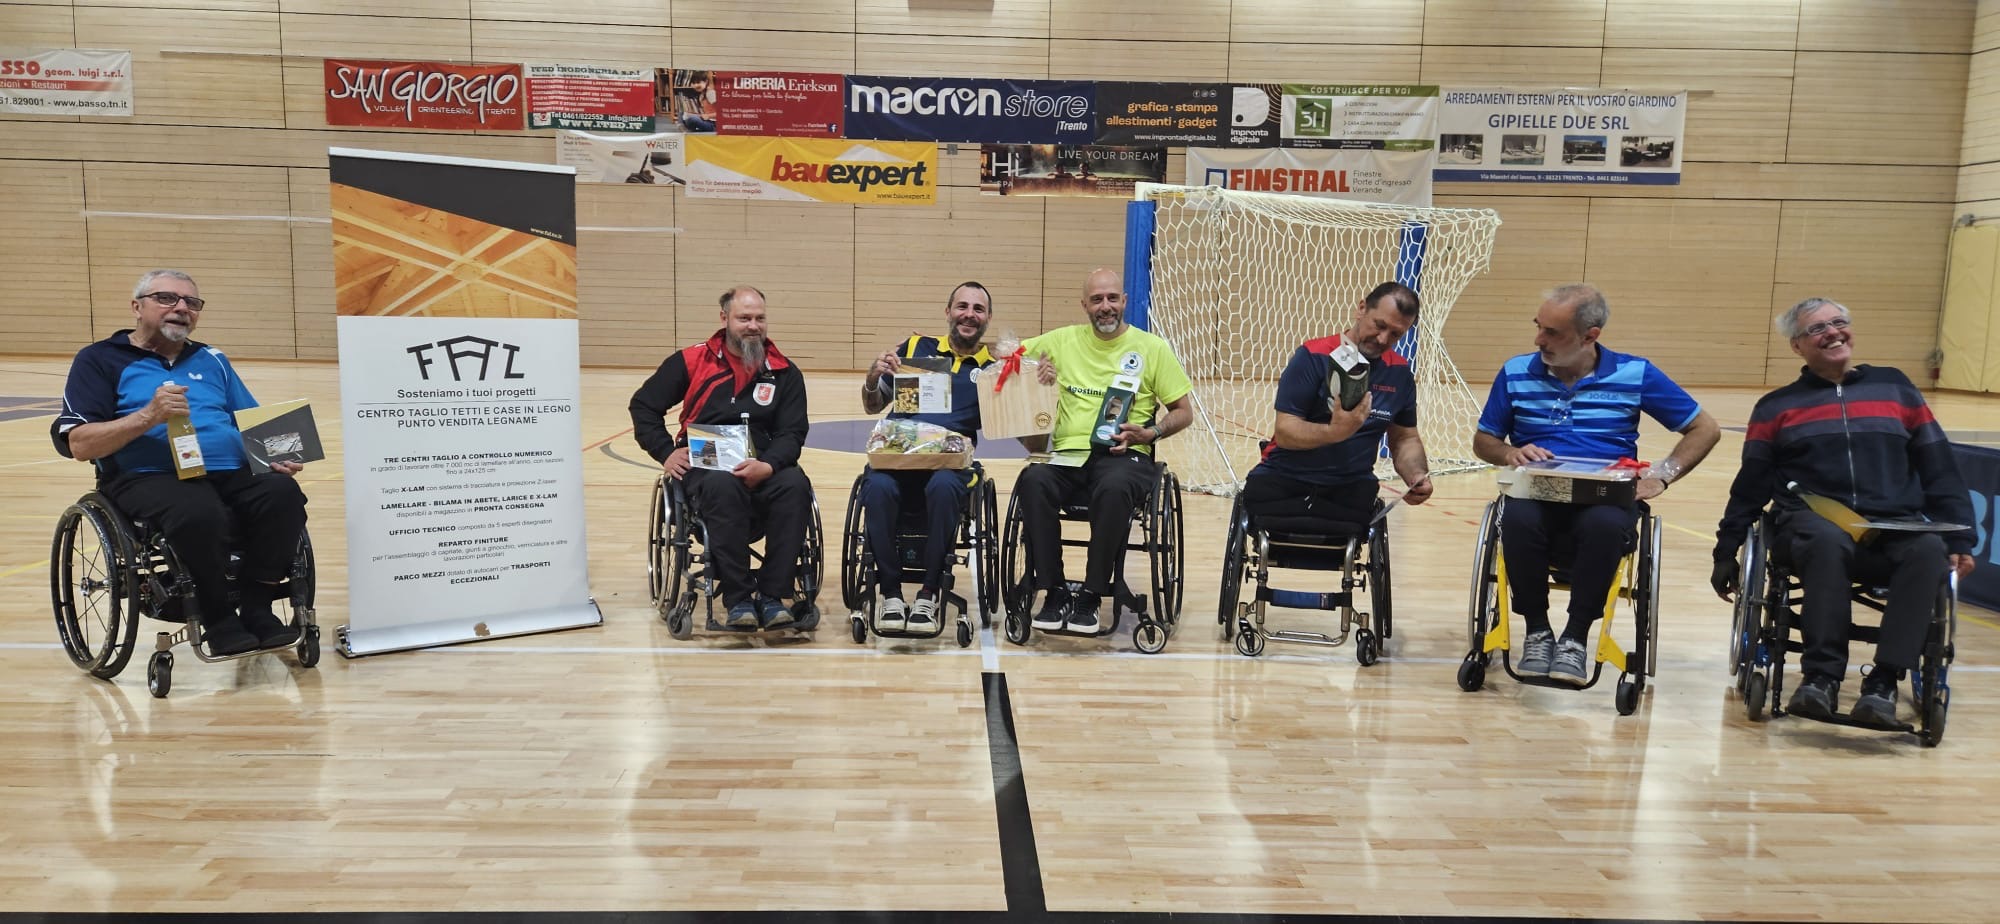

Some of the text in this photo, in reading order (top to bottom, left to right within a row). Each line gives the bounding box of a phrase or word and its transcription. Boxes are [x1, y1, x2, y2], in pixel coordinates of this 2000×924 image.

[44, 68, 75, 78] geom.
[78, 68, 100, 79] luigi
[31, 81, 67, 90] Restauri
[733, 77, 786, 90] LIBRERIA
[788, 79, 838, 92] Erickson
[1310, 86, 1370, 94] COSTRUISCE
[330, 67, 519, 124] SAN GIORGIO
[1445, 92, 1677, 108] ARREDAMENTI ESTERNI PER IL VOSTRO GIARDINO
[54, 99, 128, 108] www.basso.tn.it
[1004, 89, 1089, 118] store
[1128, 102, 1218, 114] grafica stampa
[418, 106, 474, 115] ORIENTEERING
[1106, 115, 1218, 129] allestimenti gadget
[1488, 114, 1630, 130] GIPIELLE DUE SRL
[1134, 134, 1216, 142] www.improntadigitale.biz
[1230, 128, 1268, 138] impronta
[646, 140, 678, 150] WALTER
[1230, 136, 1260, 144] digitale
[1058, 150, 1159, 161] LIVE YOUR DREAM
[992, 152, 1020, 177] Hi
[770, 154, 927, 192] bauexpert
[1353, 170, 1382, 178] Finestre
[1230, 168, 1350, 193] FINSTRAL
[1374, 178, 1412, 188] d'ingresso
[397, 389, 463, 398] Sosteniamo
[472, 388, 492, 397] tuoi
[496, 388, 536, 398] progetti
[357, 404, 571, 418] CENTRO TAGLIO TETTI E CASE IN LEGNO
[398, 416, 538, 428] PUNTO VENDITA LEGNAME
[381, 501, 426, 510] LAMELLARE
[511, 561, 551, 570] TRASPORTI
[451, 574, 500, 584] ECCEZIONALI
